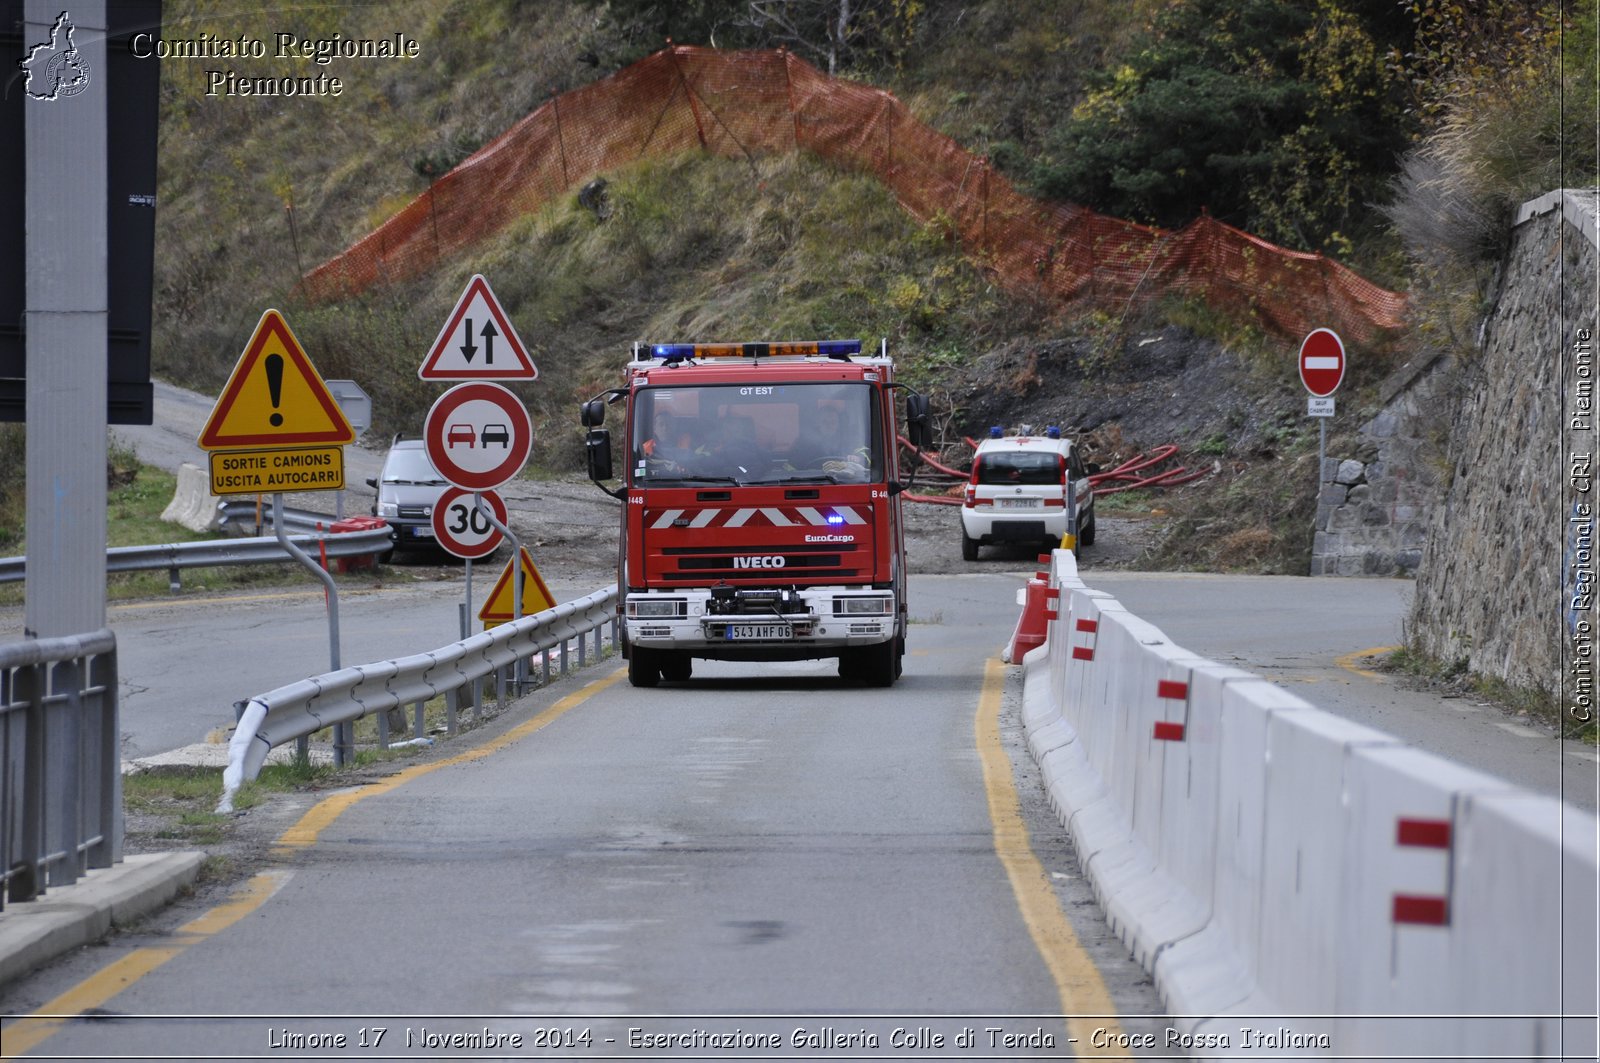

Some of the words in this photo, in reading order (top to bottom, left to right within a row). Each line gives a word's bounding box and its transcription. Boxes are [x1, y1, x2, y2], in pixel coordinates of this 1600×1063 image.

[740, 387, 753, 395] GT
[755, 386, 773, 395] EST
[223, 457, 267, 470] SORTIE
[273, 454, 331, 467] CAMIONS
[216, 475, 261, 487] USCITA
[268, 471, 339, 485] AUTOCARRI
[449, 504, 491, 534] 30
[805, 534, 855, 543] EuroCargo
[733, 555, 786, 569] IVECO
[734, 627, 753, 638] 543
[756, 626, 775, 638] AHF
[778, 626, 791, 637] 06
